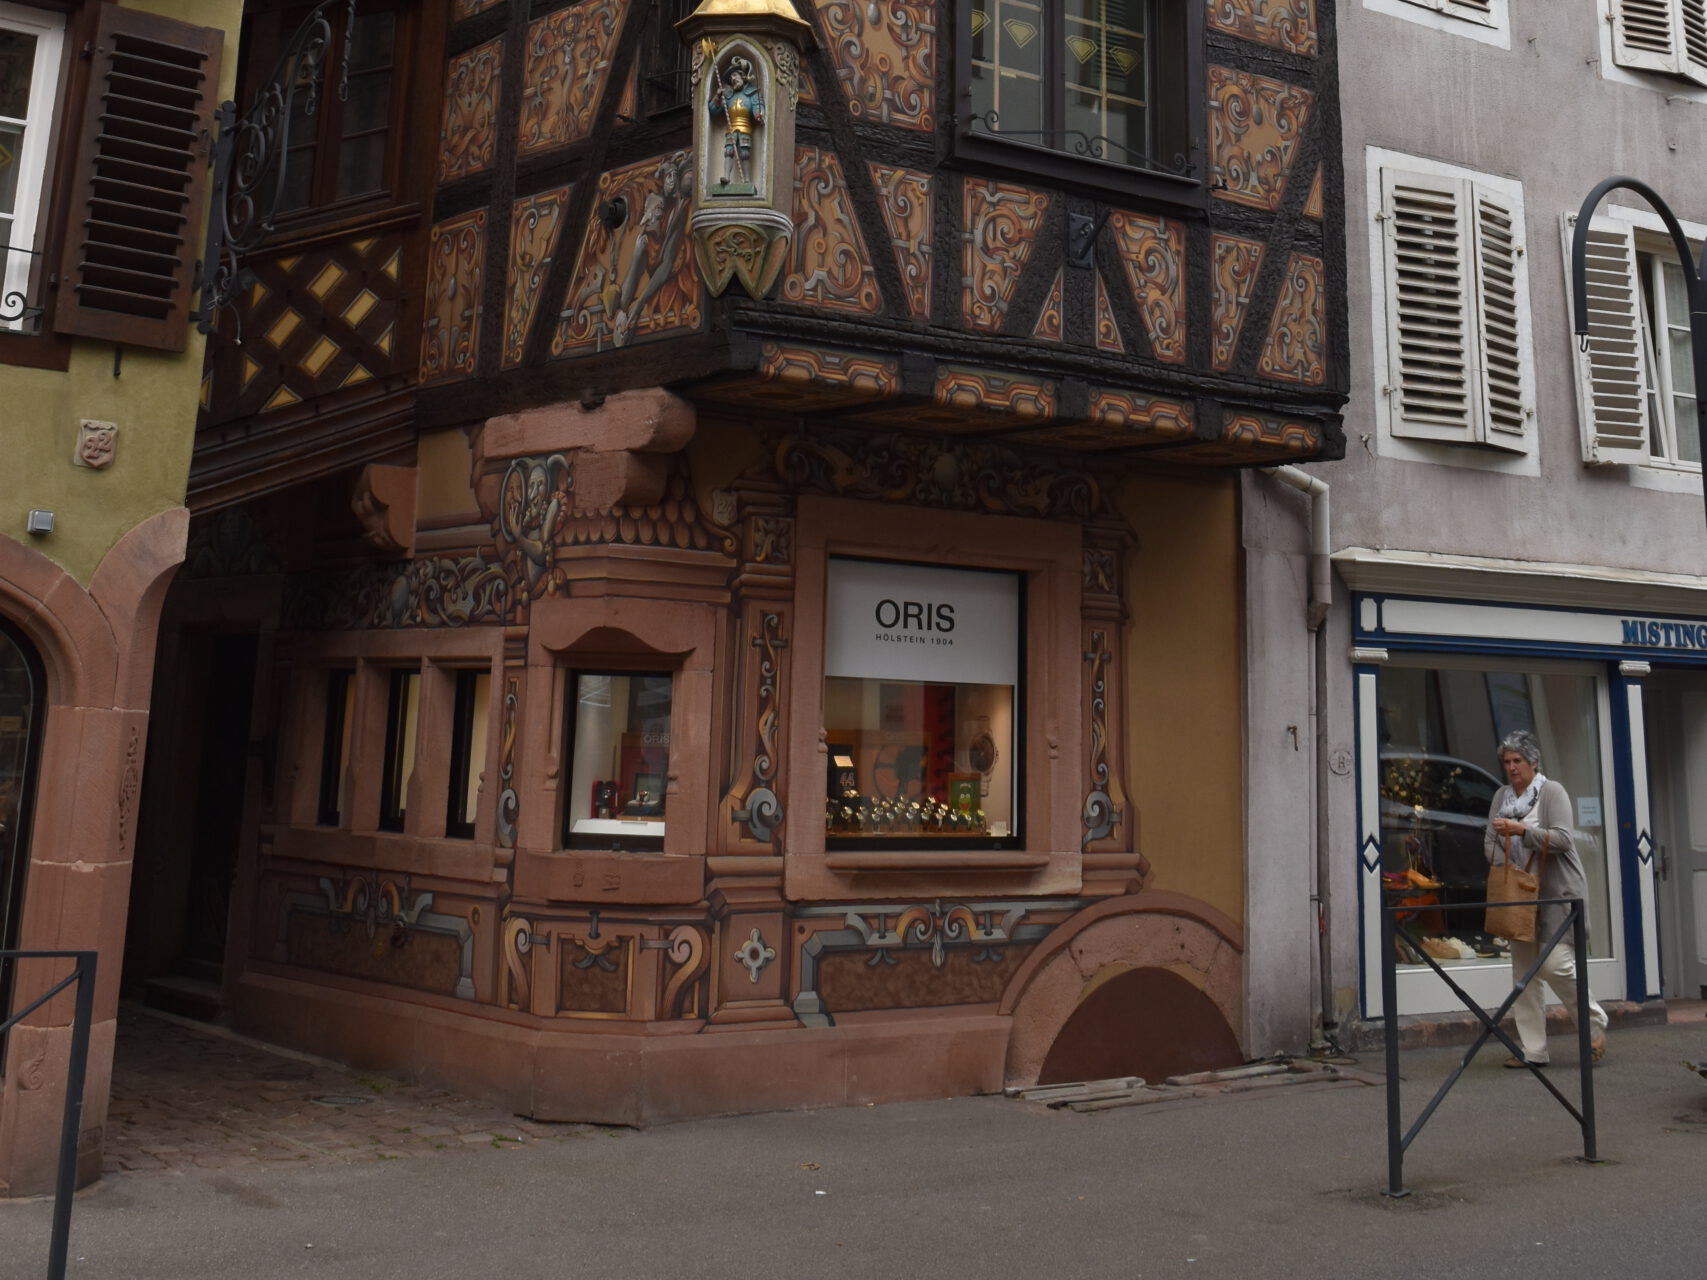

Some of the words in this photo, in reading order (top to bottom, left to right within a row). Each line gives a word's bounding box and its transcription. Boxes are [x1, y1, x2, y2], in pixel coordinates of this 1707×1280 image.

[82, 429, 112, 460] 22
[875, 598, 956, 633] ORIS
[930, 637, 953, 646] 1904
[1621, 619, 1707, 649] MISTING
[643, 735, 670, 745] ORIS
